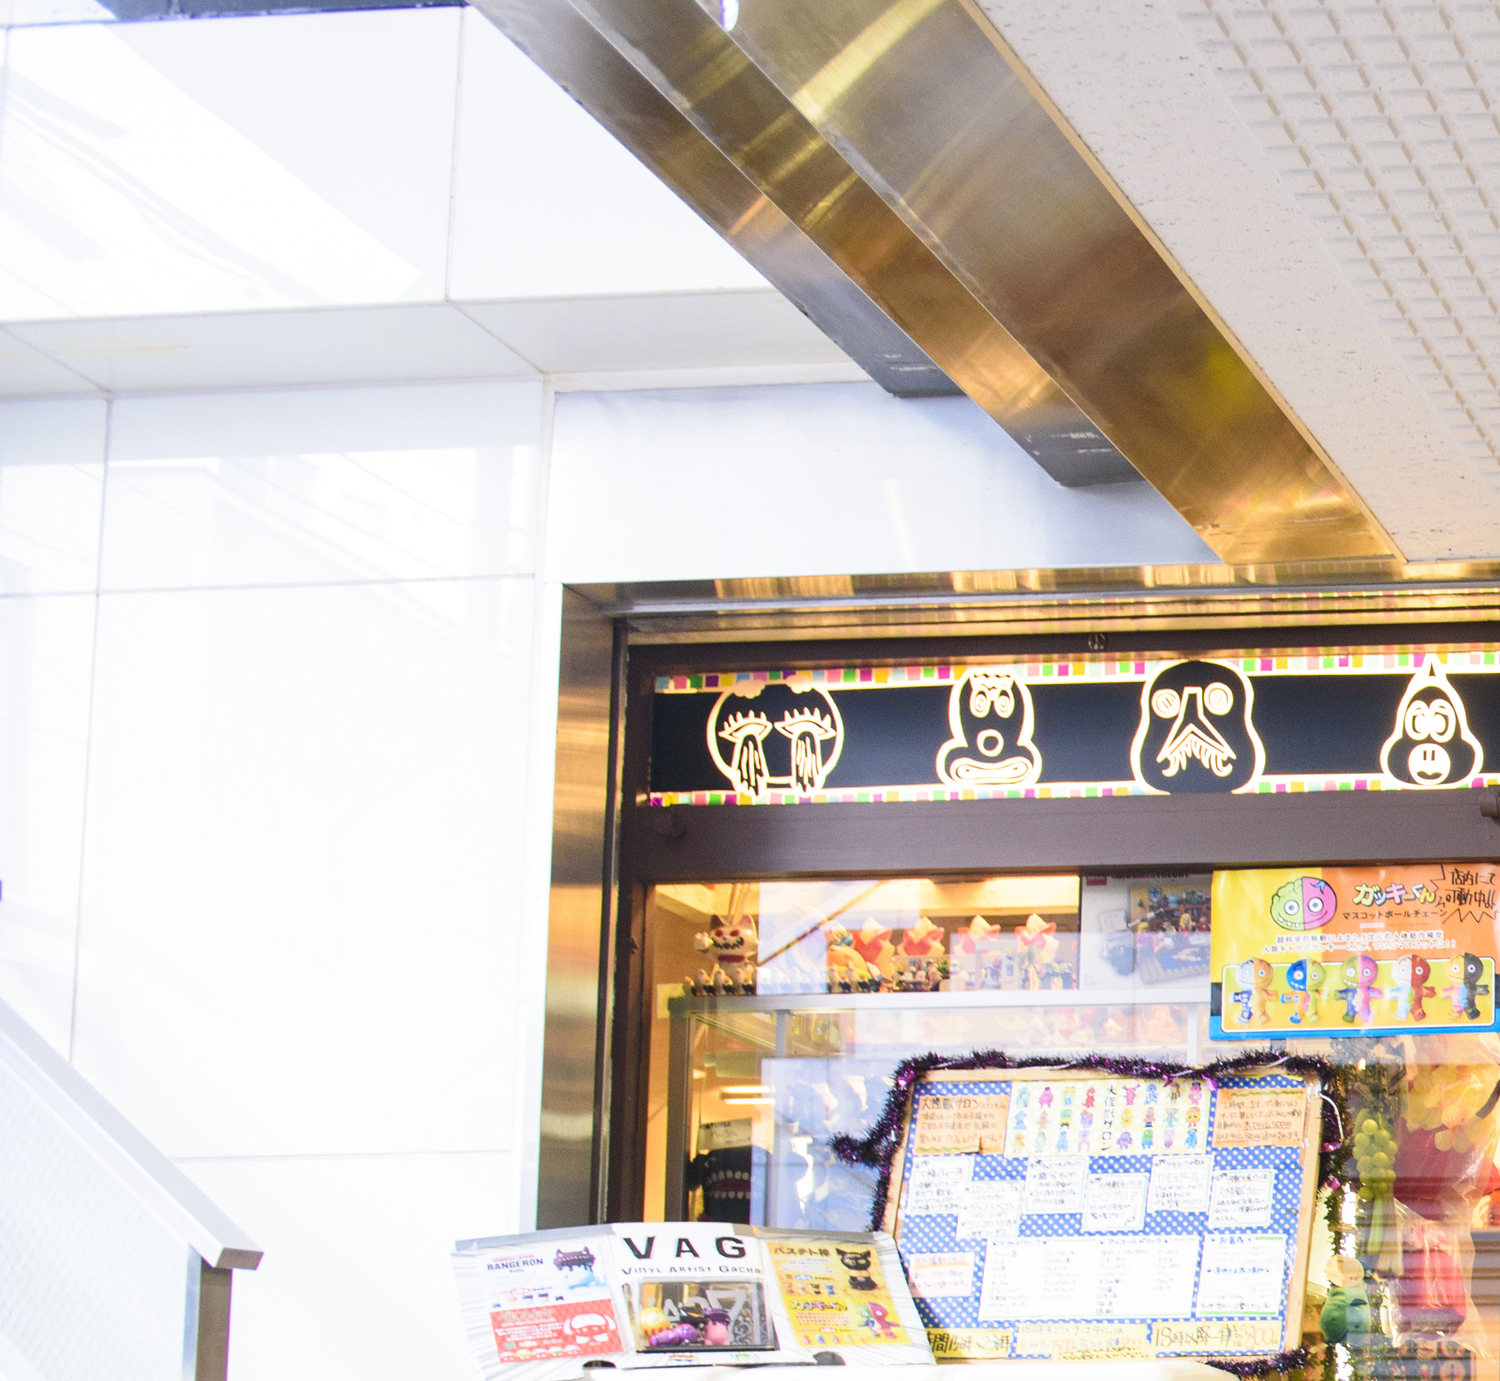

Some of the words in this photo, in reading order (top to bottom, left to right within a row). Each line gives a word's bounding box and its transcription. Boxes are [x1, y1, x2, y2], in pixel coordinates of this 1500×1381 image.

[1352, 883, 1436, 907] ガッキーくん
[1342, 909, 1447, 920] マスコットボールチェーン
[623, 1236, 747, 1260] VAG
[774, 1247, 830, 1257] バステト神
